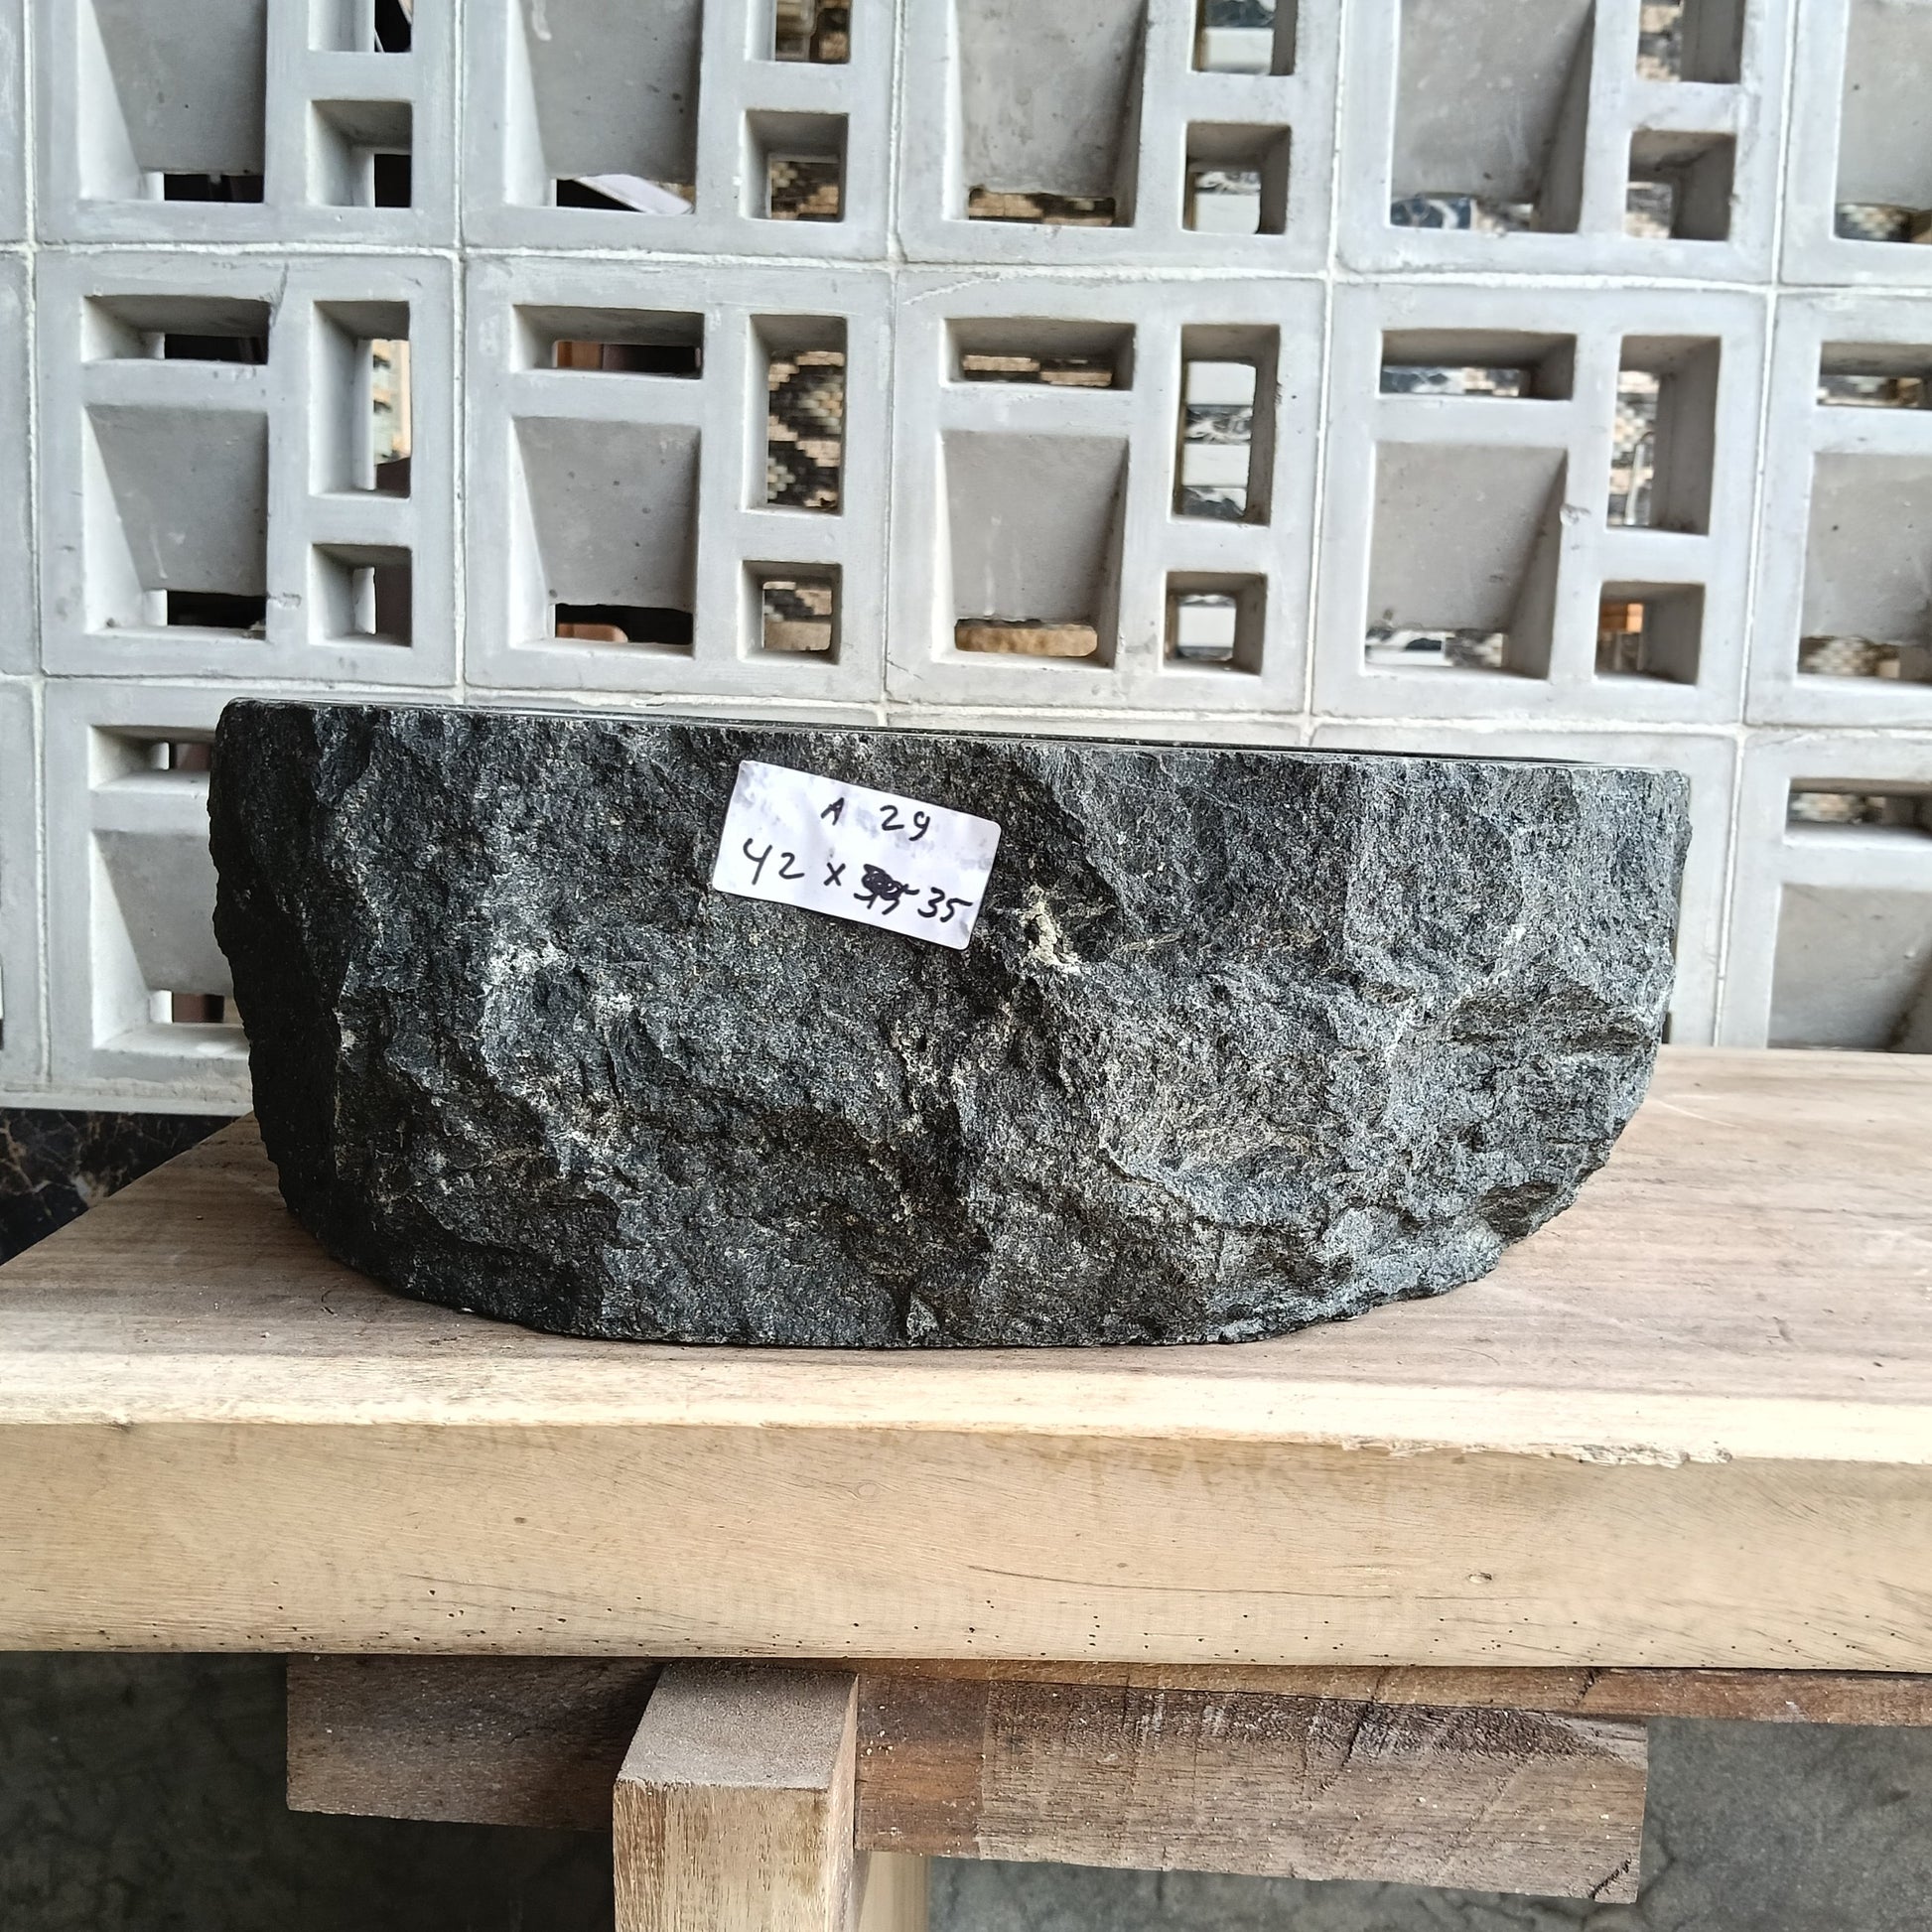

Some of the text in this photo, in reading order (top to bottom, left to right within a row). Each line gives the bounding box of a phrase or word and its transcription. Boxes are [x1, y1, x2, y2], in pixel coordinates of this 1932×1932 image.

[820, 797, 930, 842] A 29
[743, 838, 805, 886] 42
[917, 887, 973, 922] 35
